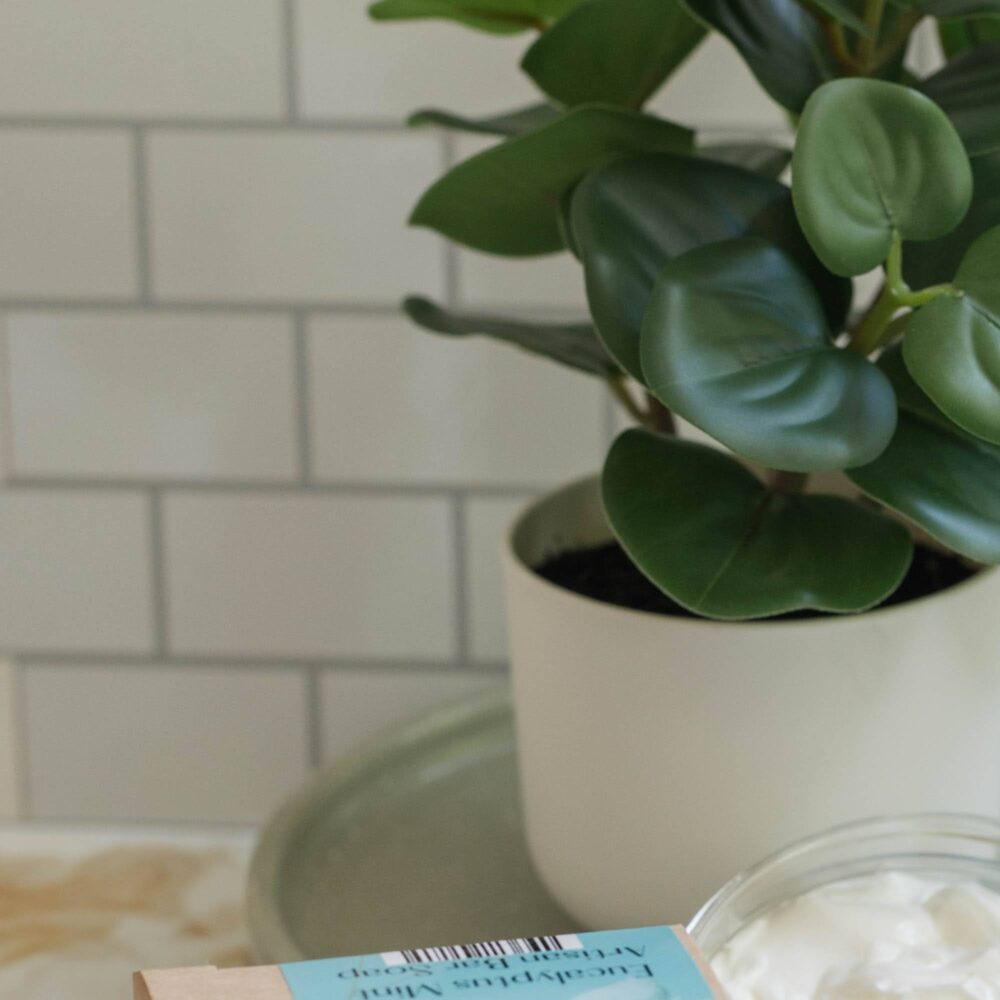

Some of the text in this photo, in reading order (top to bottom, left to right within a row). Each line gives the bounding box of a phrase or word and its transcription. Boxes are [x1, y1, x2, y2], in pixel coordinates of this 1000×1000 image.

[337, 944, 647, 980] Artisan Bar Soap
[360, 963, 655, 1000] Eucalyptus Mint
